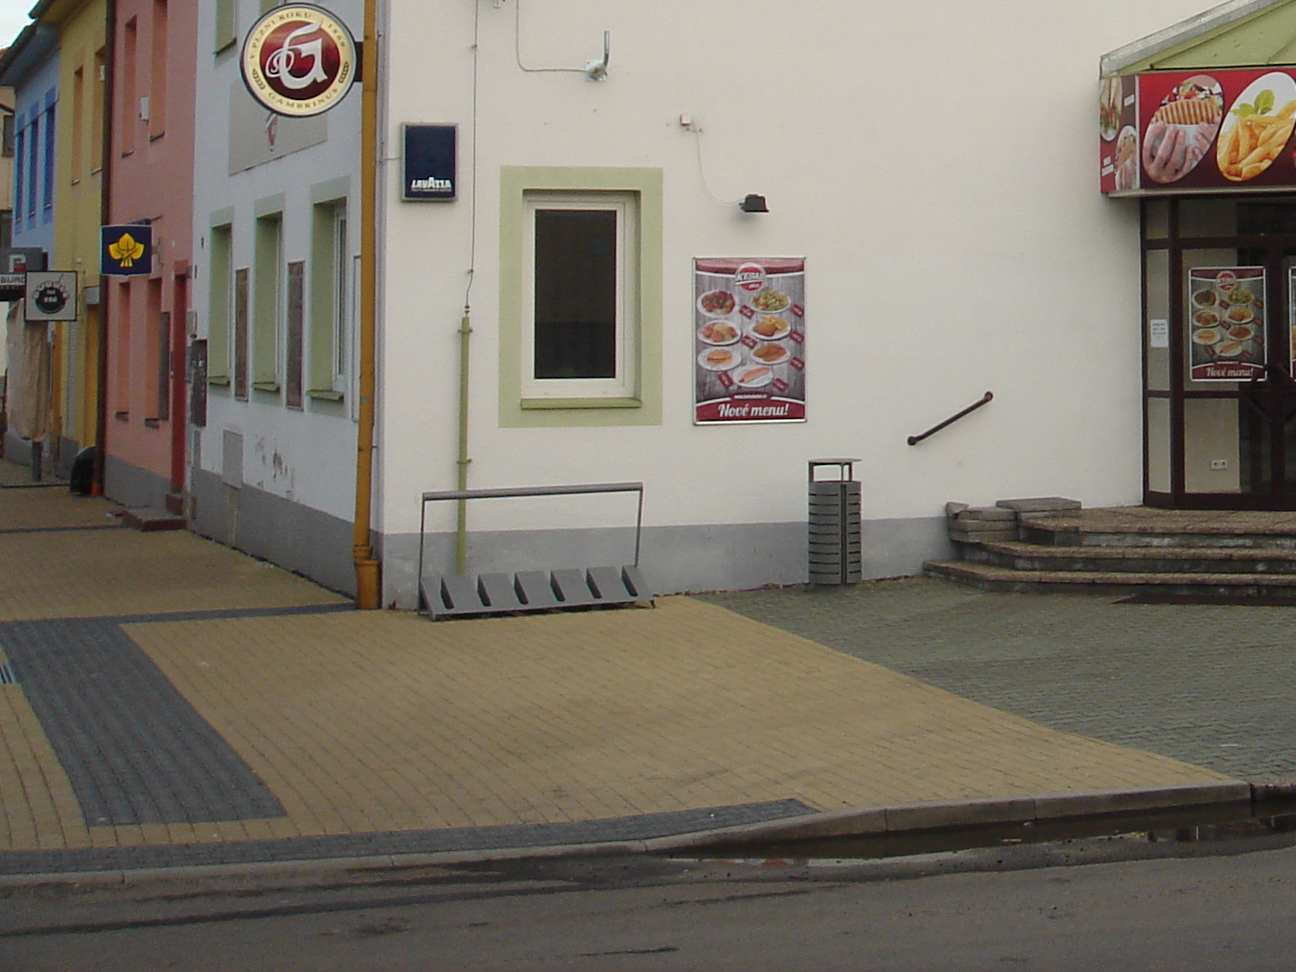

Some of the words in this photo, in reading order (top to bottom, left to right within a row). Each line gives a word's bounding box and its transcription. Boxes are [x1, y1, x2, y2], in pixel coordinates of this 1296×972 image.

[278, 10, 312, 21] ROKU
[268, 88, 339, 110] GAMBRINUS
[718, 403, 748, 418] Nové
[750, 404, 790, 417] menu!
